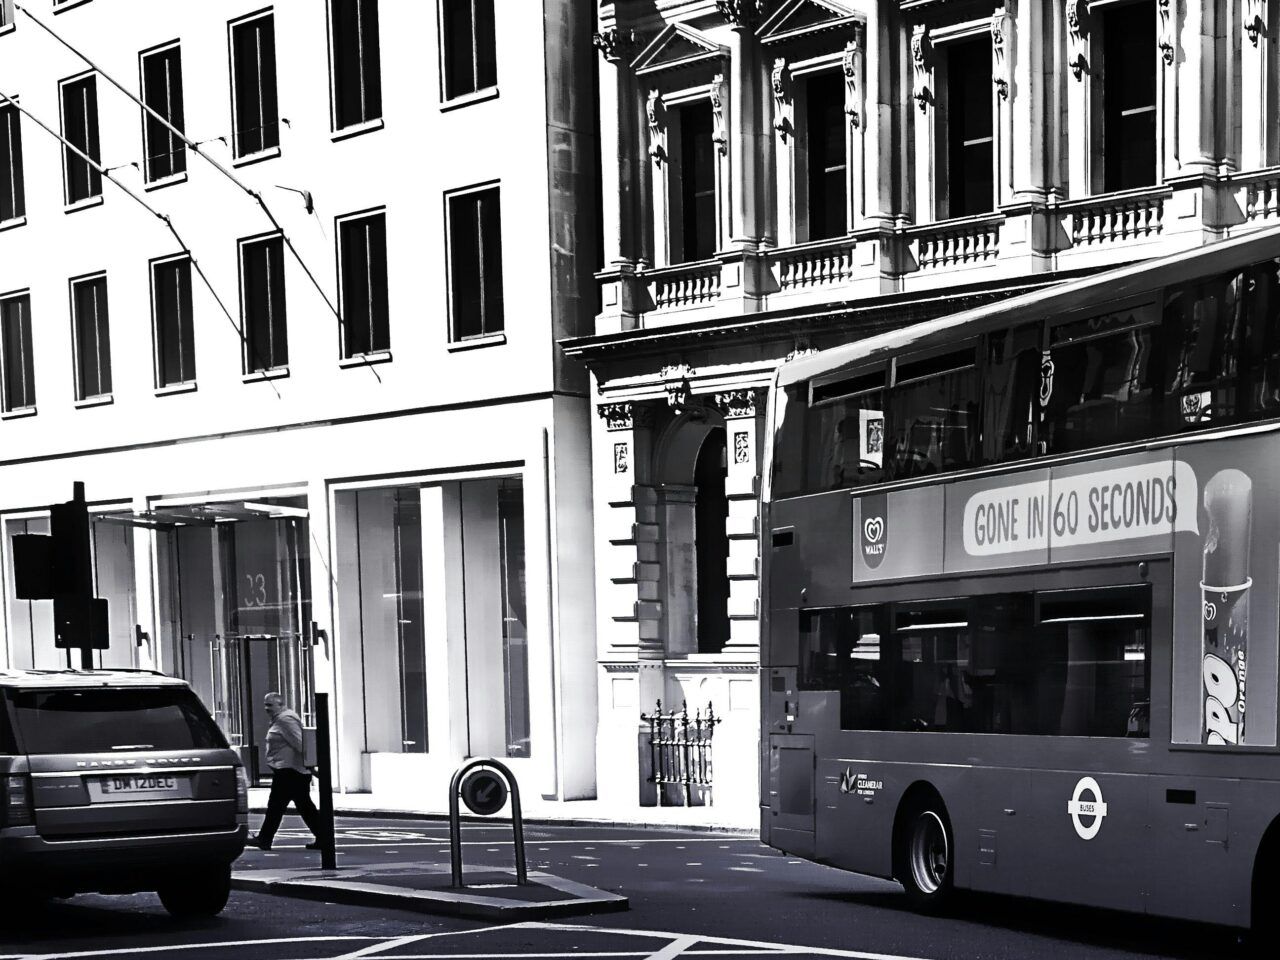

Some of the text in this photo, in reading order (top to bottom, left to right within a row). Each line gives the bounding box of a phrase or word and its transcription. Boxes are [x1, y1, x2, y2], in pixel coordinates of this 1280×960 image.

[974, 475, 1178, 546] GONE IN 60 SECONDS
[1237, 650, 1246, 713] Orange
